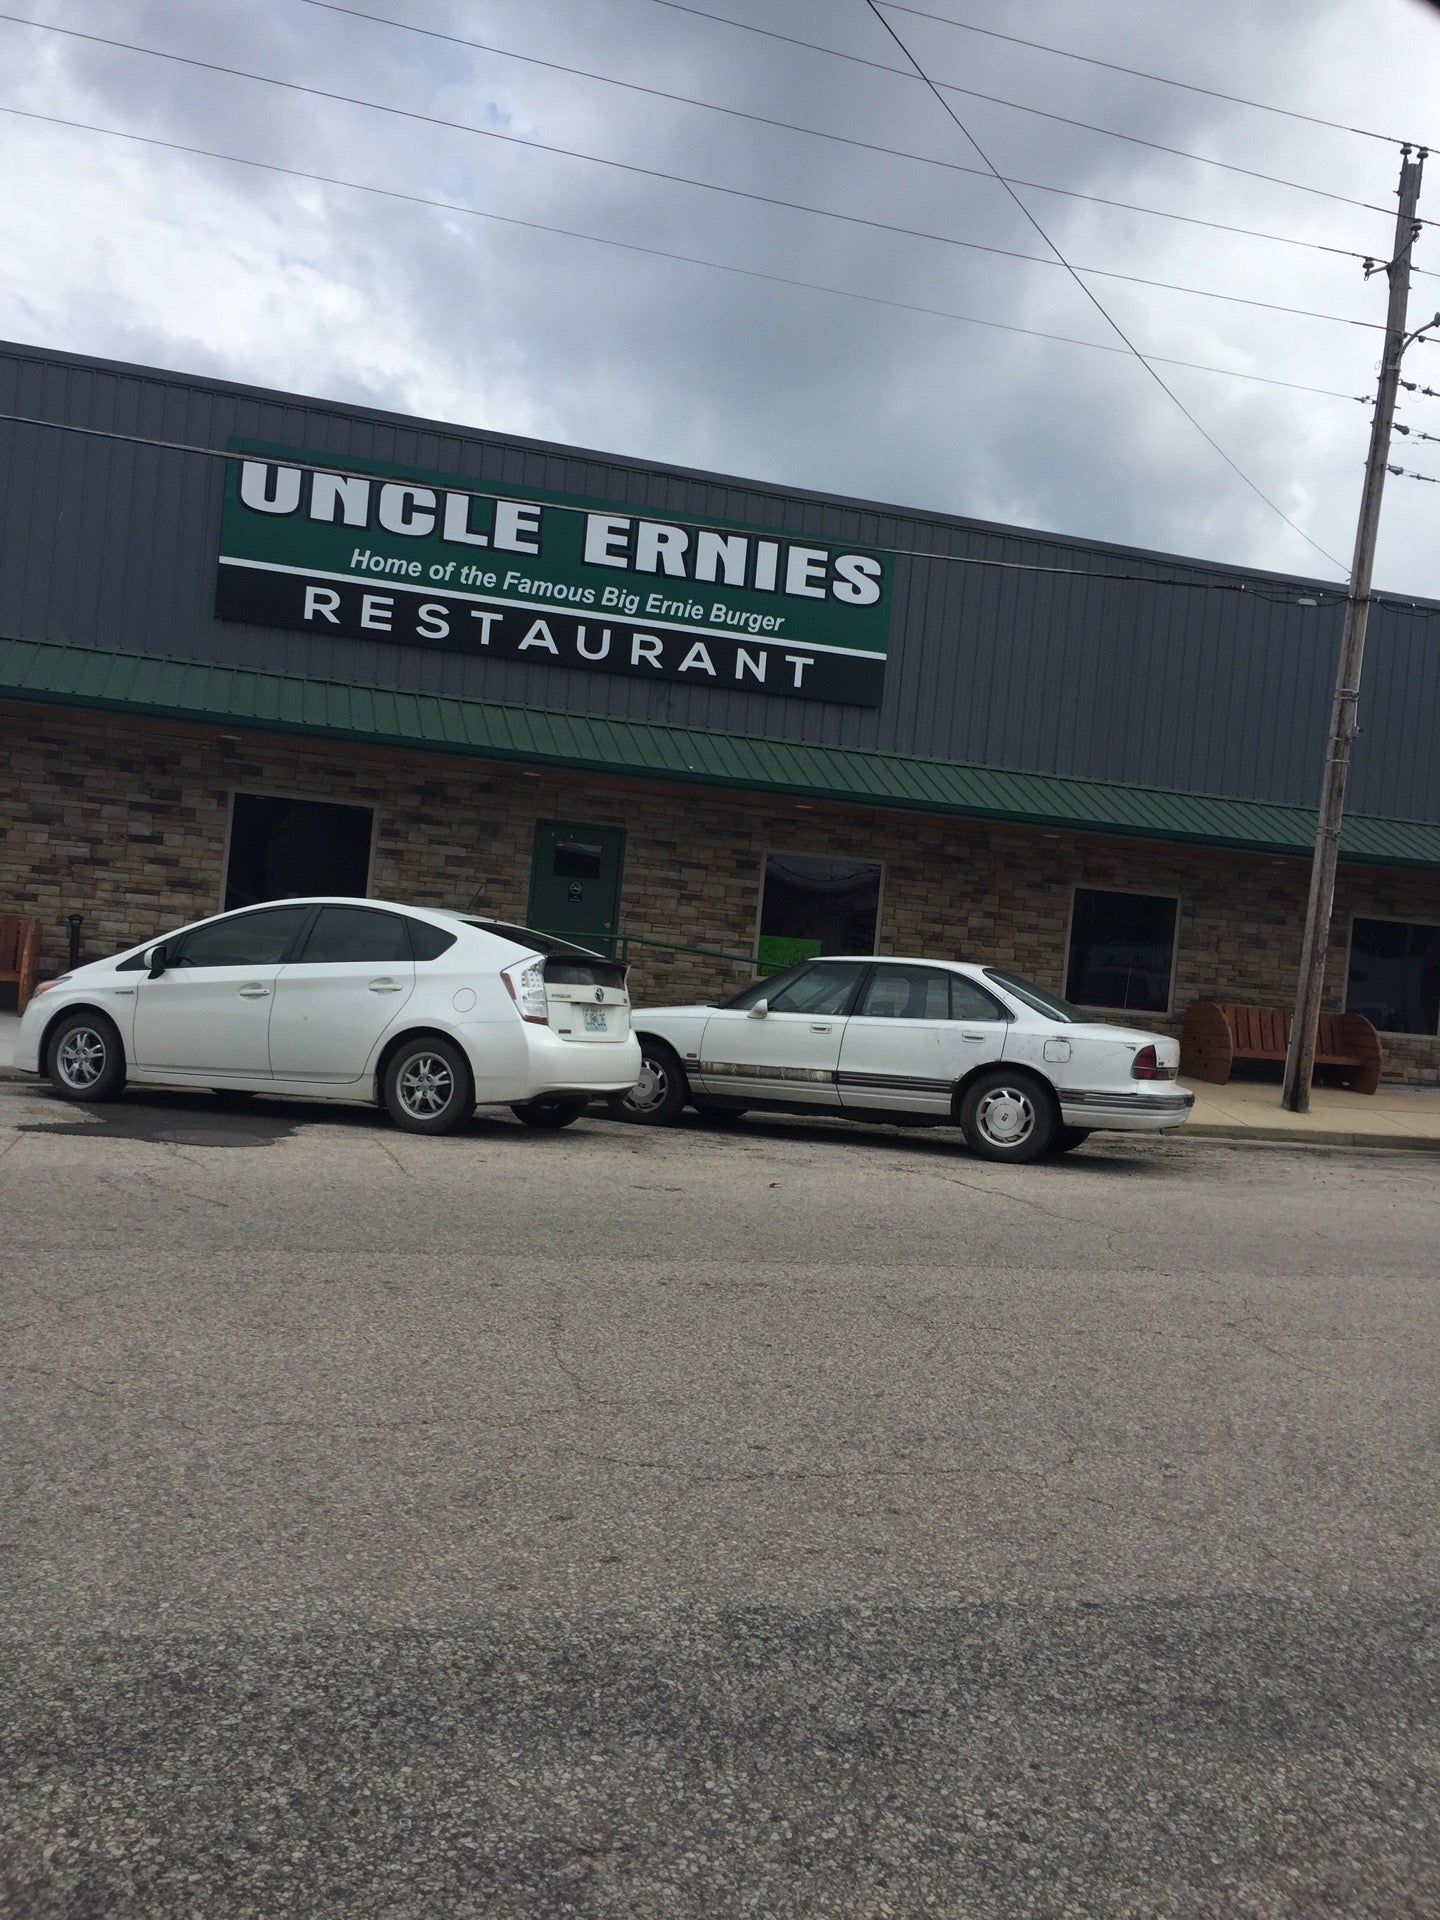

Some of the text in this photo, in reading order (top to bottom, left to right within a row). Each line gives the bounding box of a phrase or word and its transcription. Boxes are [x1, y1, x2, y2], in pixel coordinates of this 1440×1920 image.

[240, 461, 882, 605] UNCLE ERNIES
[303, 585, 815, 689] RESTAURANT
[350, 548, 785, 633] Home of the Famous Big Ernie Burger
